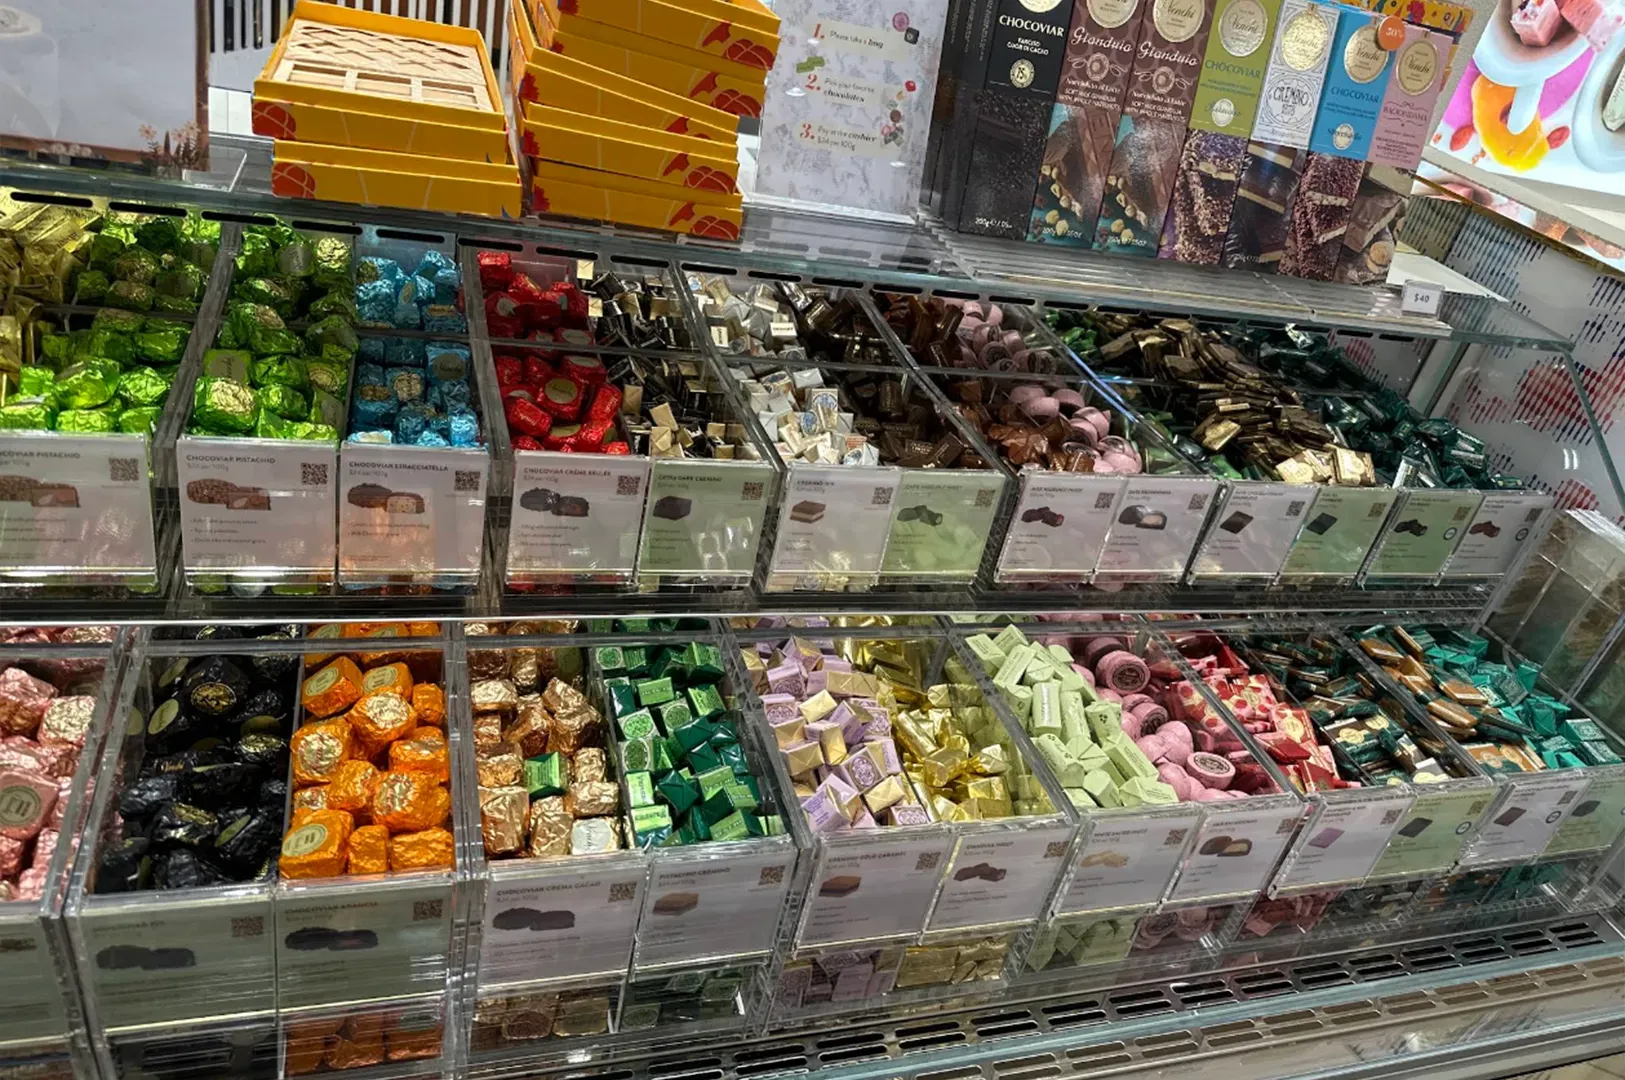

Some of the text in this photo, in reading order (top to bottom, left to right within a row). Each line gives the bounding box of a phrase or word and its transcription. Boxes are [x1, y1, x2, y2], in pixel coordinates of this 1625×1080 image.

[999, 15, 1065, 37] CHOCOVIAR
[868, 39, 884, 49] bag
[1204, 59, 1261, 79] CHOCOVIAR
[823, 89, 866, 102] chocolates
[1330, 86, 1380, 103] CHOCOVIAR
[36, 451, 81, 460] PISTACHIO
[186, 454, 276, 464] CHOCOVIAR PISTACHIO
[349, 461, 448, 473] CHOCOVIAR STRACCIATELLA
[524, 467, 563, 475] CHOCOVIAR
[497, 881, 601, 896] CHOCOVIAR CREMA CACAO
